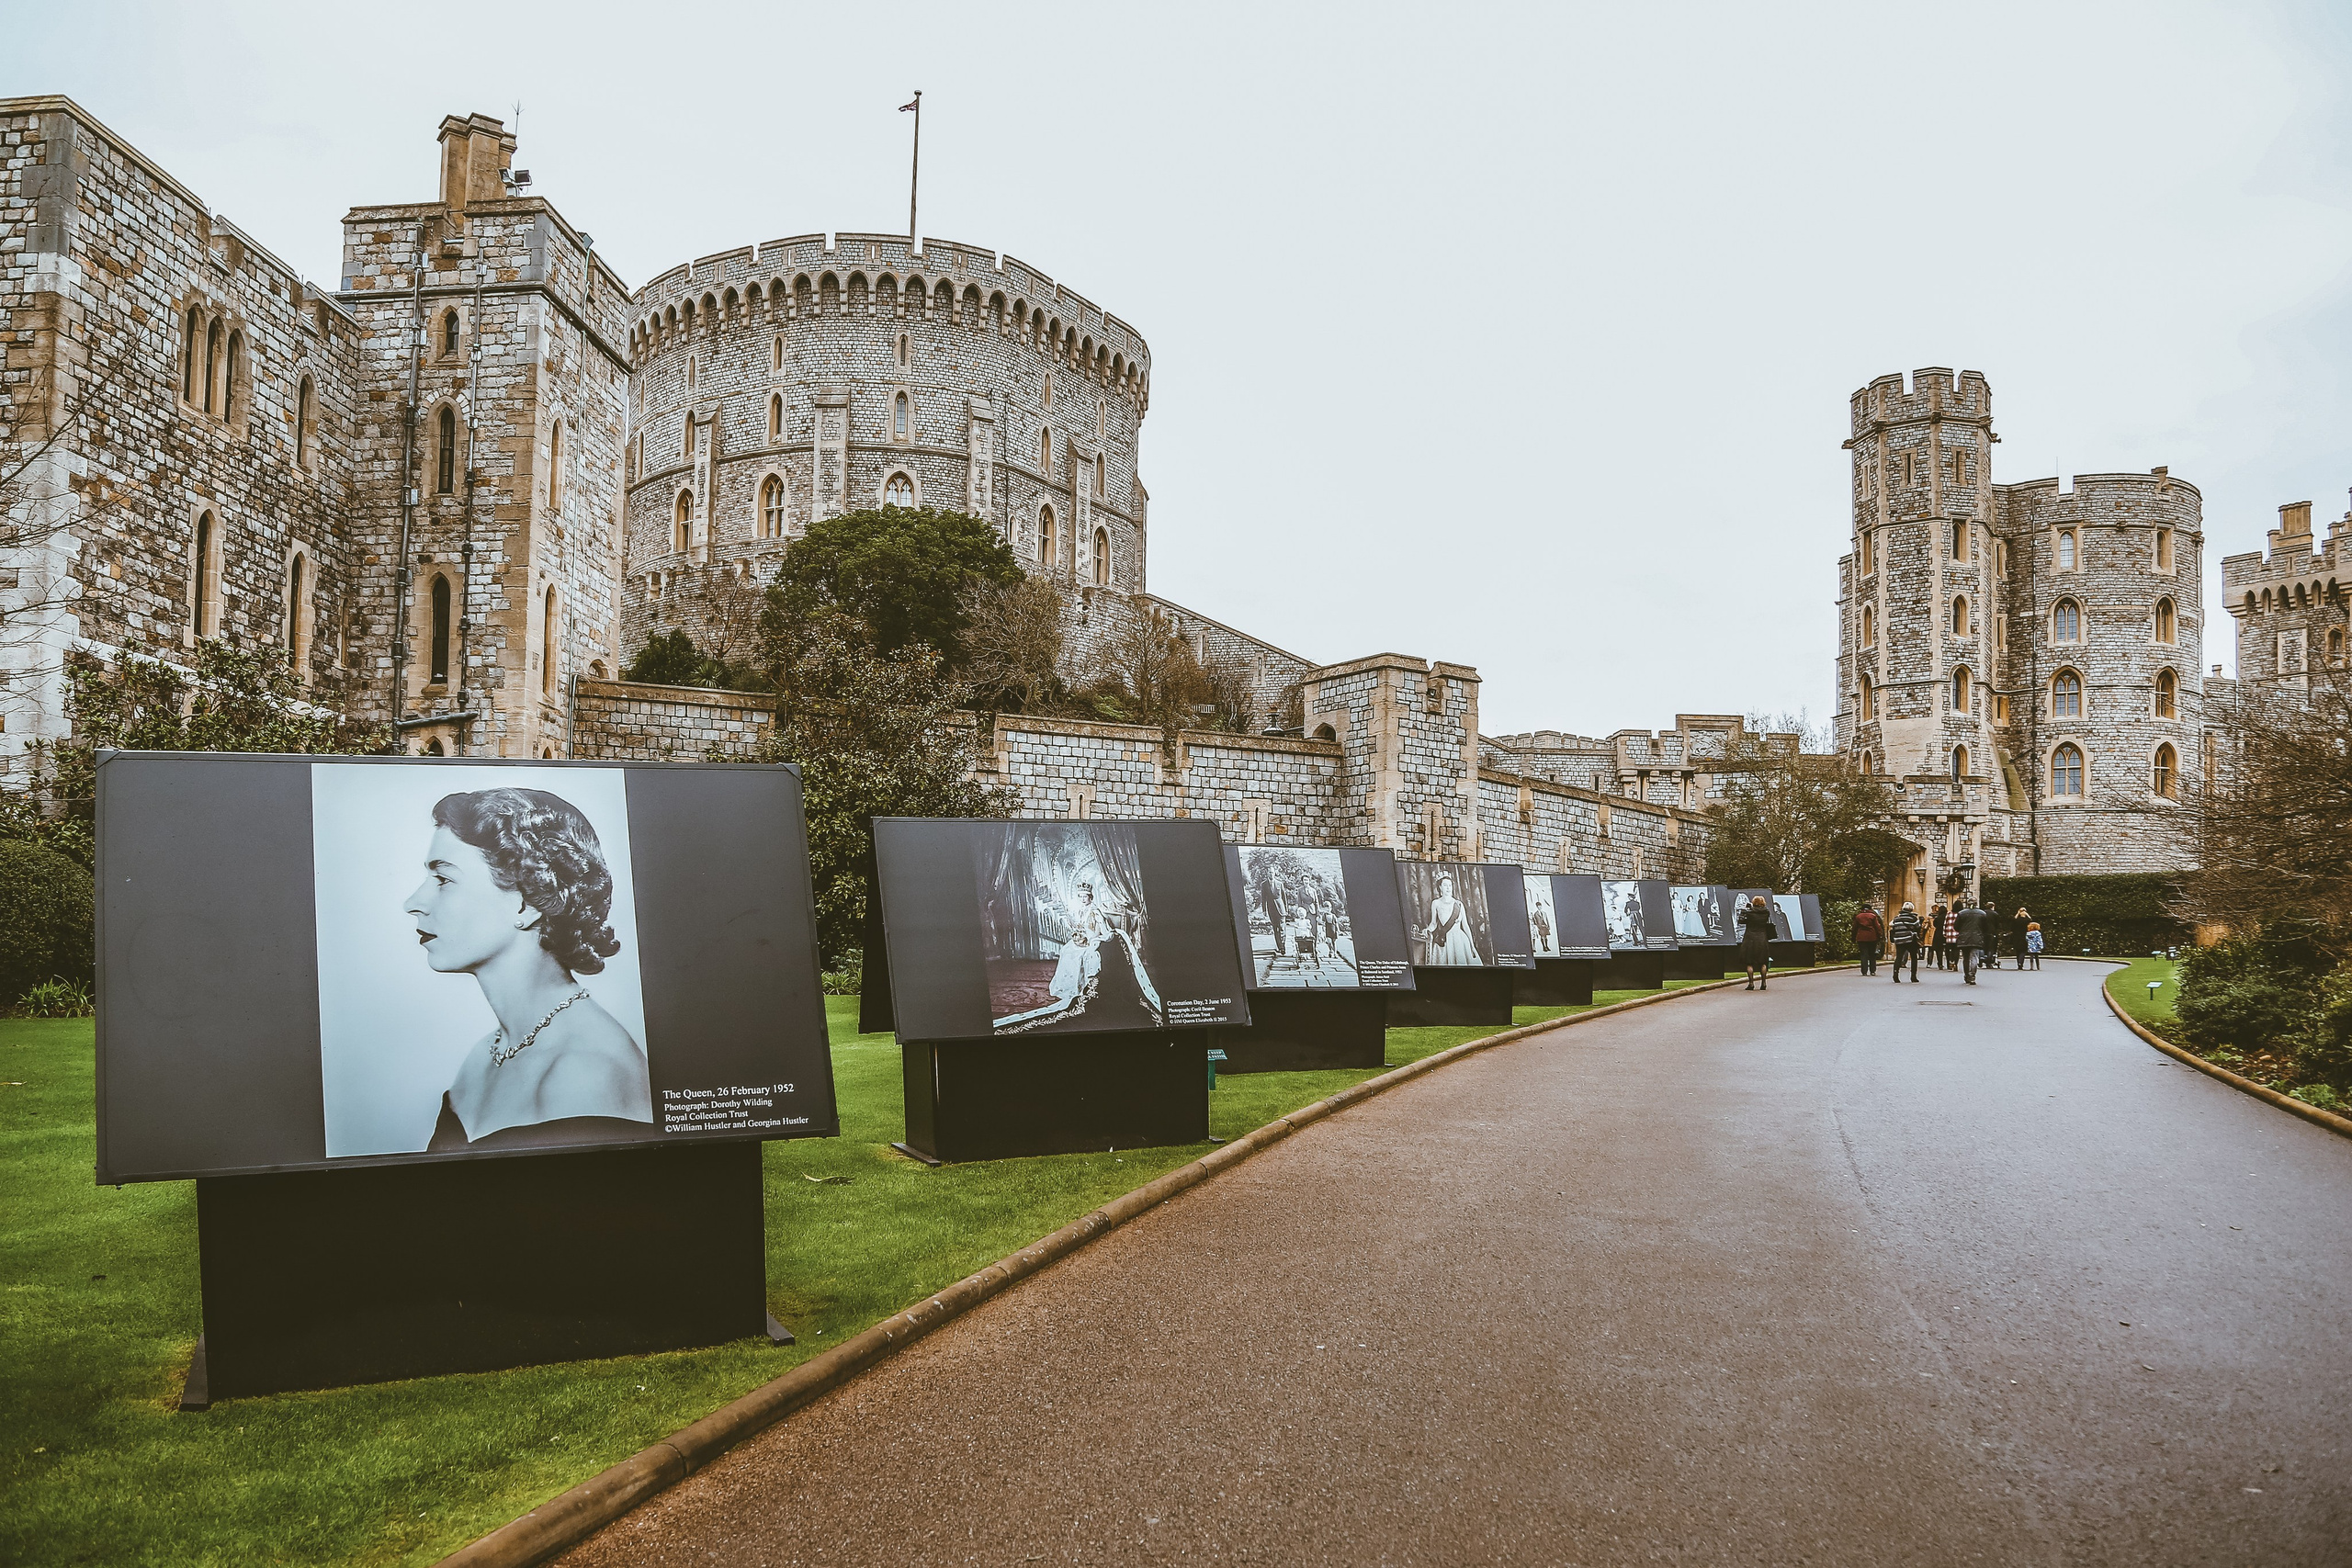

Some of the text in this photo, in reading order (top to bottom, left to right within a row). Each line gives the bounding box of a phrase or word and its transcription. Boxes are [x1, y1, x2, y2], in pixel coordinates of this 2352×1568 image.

[662, 1083, 794, 1100] The Queen, 26 February 1952
[664, 1103, 709, 1112] Photograph:
[743, 1099, 773, 1107] Wilding
[665, 1114, 687, 1122] Royal
[665, 1123, 703, 1133] ©William
[732, 1121, 746, 1129] and
[748, 1119, 781, 1128] Georgina
